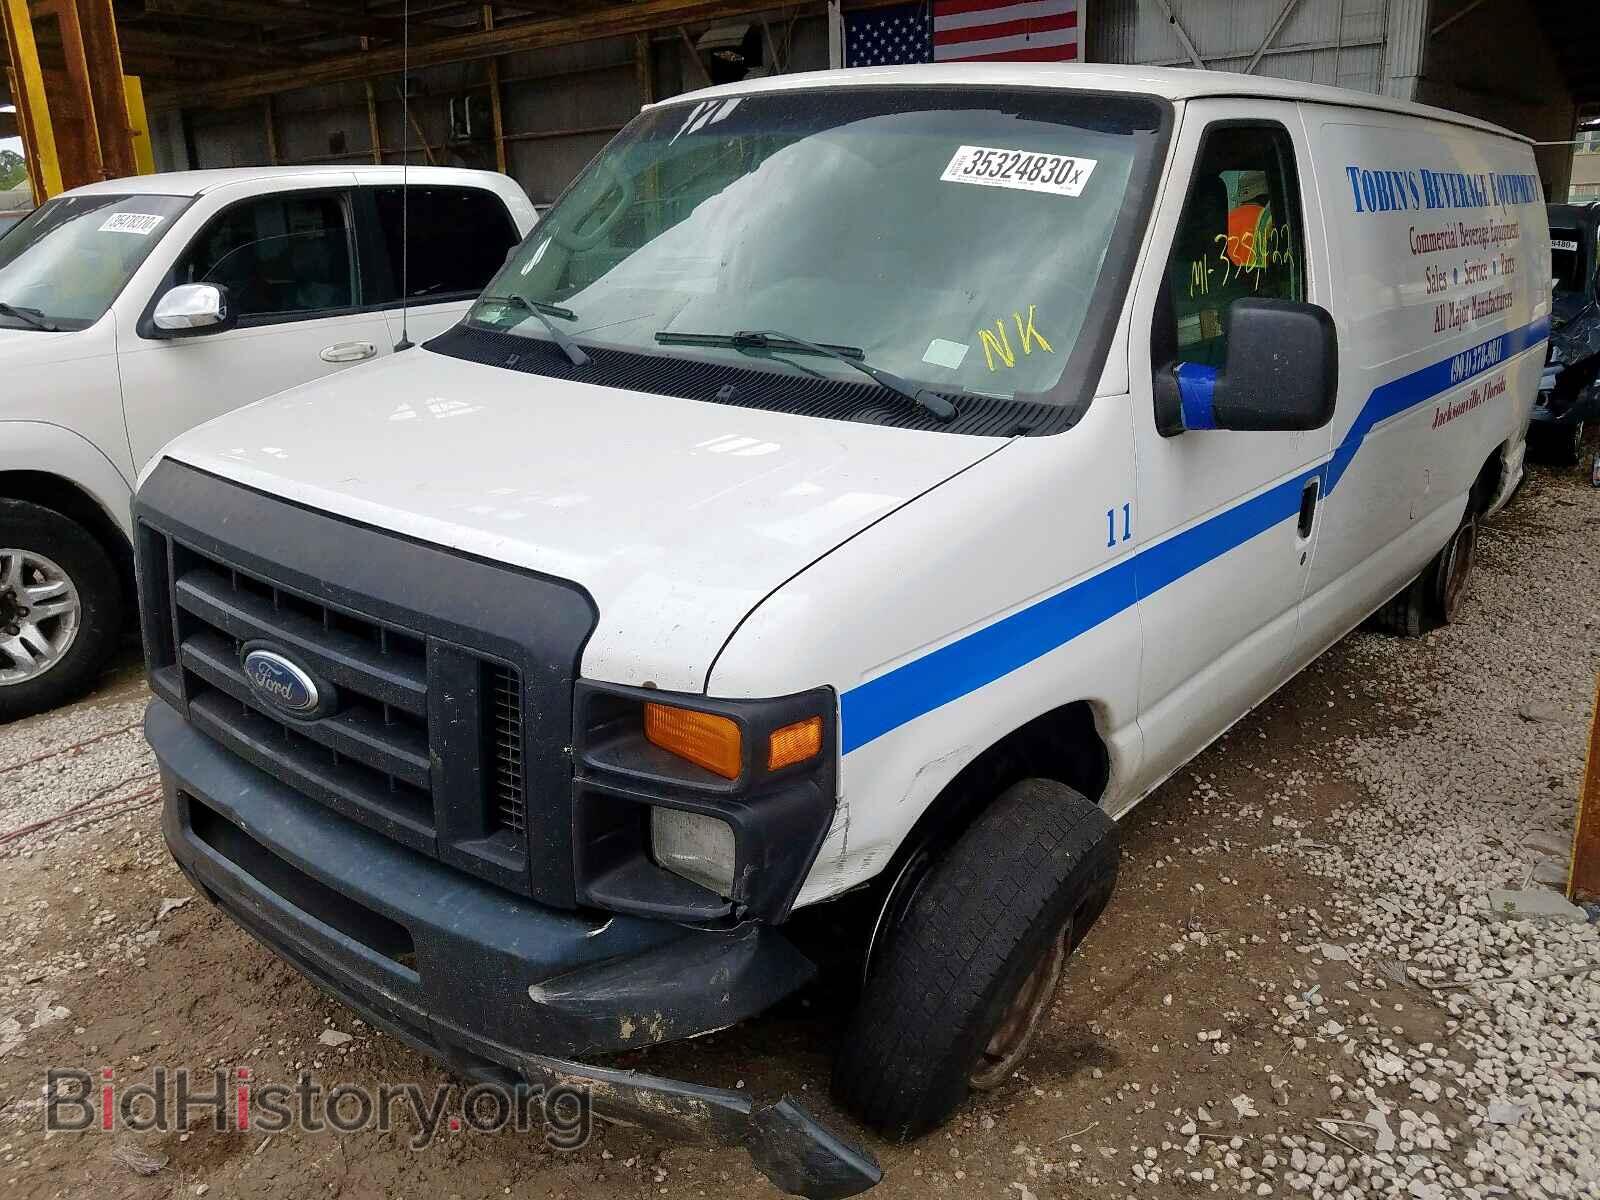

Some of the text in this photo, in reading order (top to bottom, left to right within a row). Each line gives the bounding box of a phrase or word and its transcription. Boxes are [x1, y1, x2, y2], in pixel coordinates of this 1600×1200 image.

[1346, 166, 1421, 212] TOBIN'S
[1420, 168, 1490, 209] BEVERAGE
[1409, 223, 1458, 256] Commercial
[1459, 222, 1489, 250] Beverage
[1425, 252, 1516, 295] Sales Service Parts
[1433, 290, 1513, 334] All Major Manufacturers
[1482, 375, 1507, 402] Florida
[1106, 502, 1131, 548] 11
[256, 661, 293, 700] Ford
